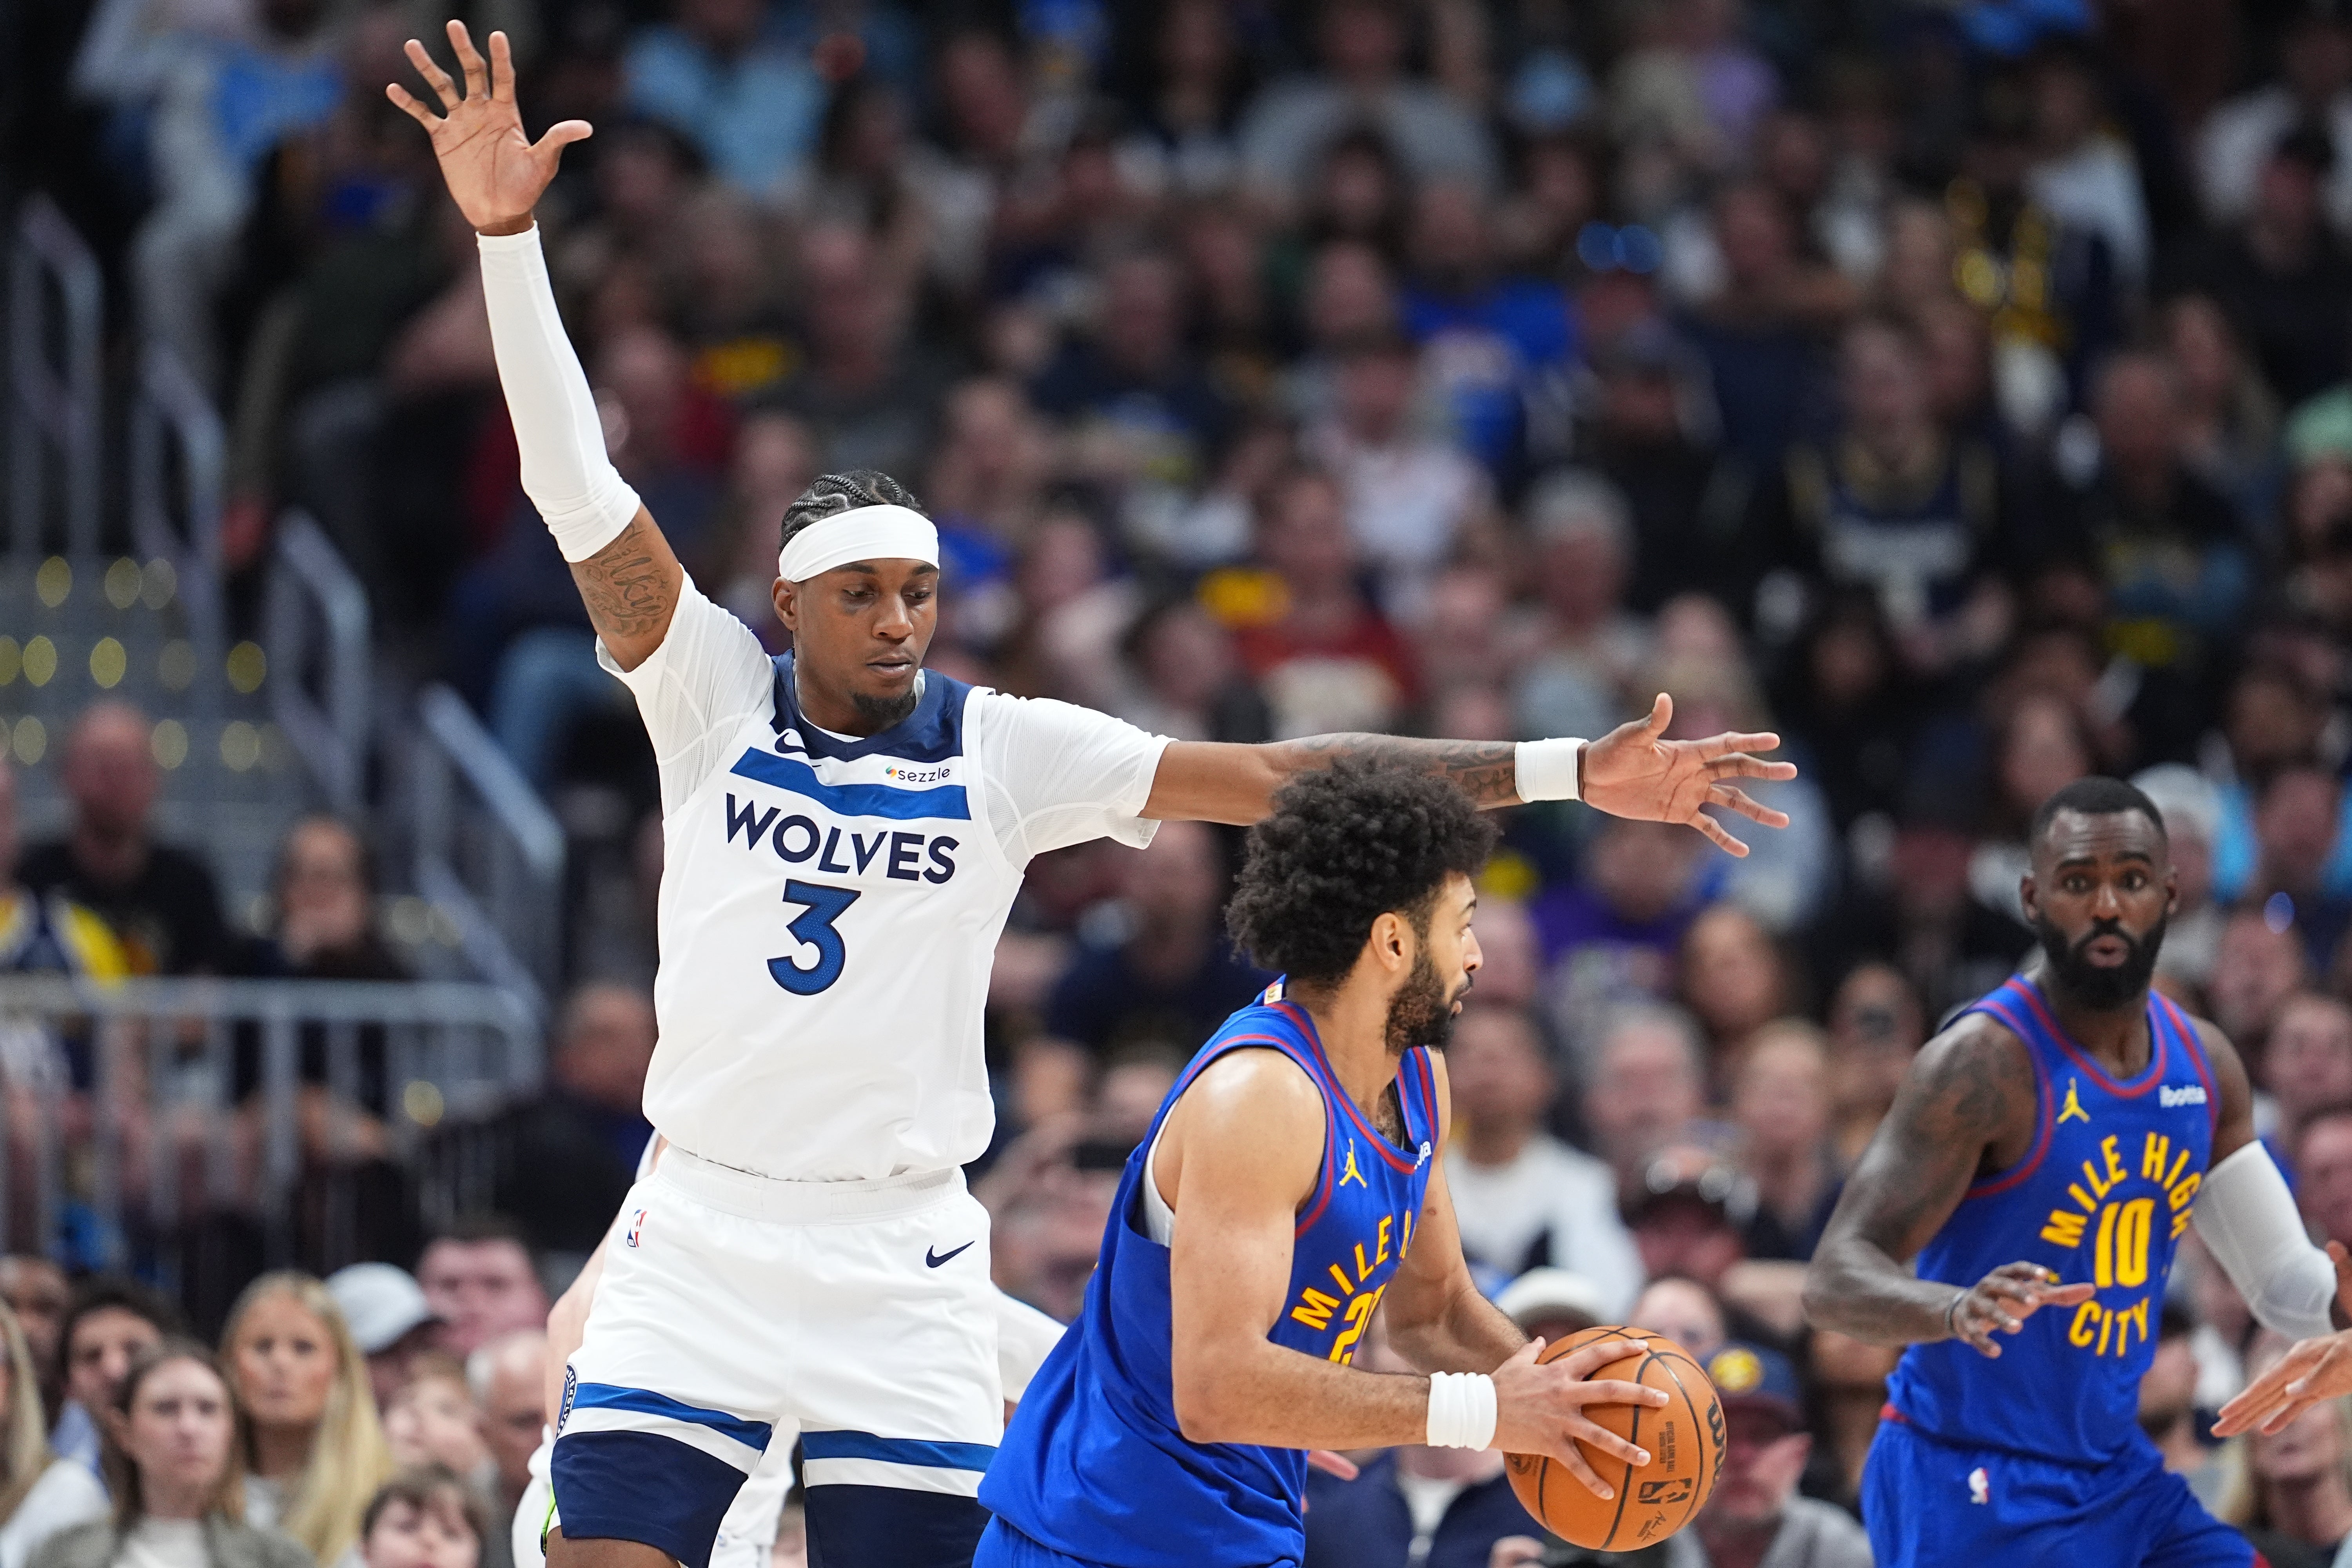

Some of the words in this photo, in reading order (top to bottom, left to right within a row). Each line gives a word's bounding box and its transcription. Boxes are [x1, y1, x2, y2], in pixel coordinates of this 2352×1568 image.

[898, 767, 950, 782] sezzle
[726, 792, 960, 884] WOLVES
[767, 878, 862, 996] 3
[2040, 1135, 2127, 1248] MILE
[1291, 1215, 1392, 1331] MILE
[2094, 1198, 2155, 1289] 10
[2069, 1298, 2149, 1357] CITY
